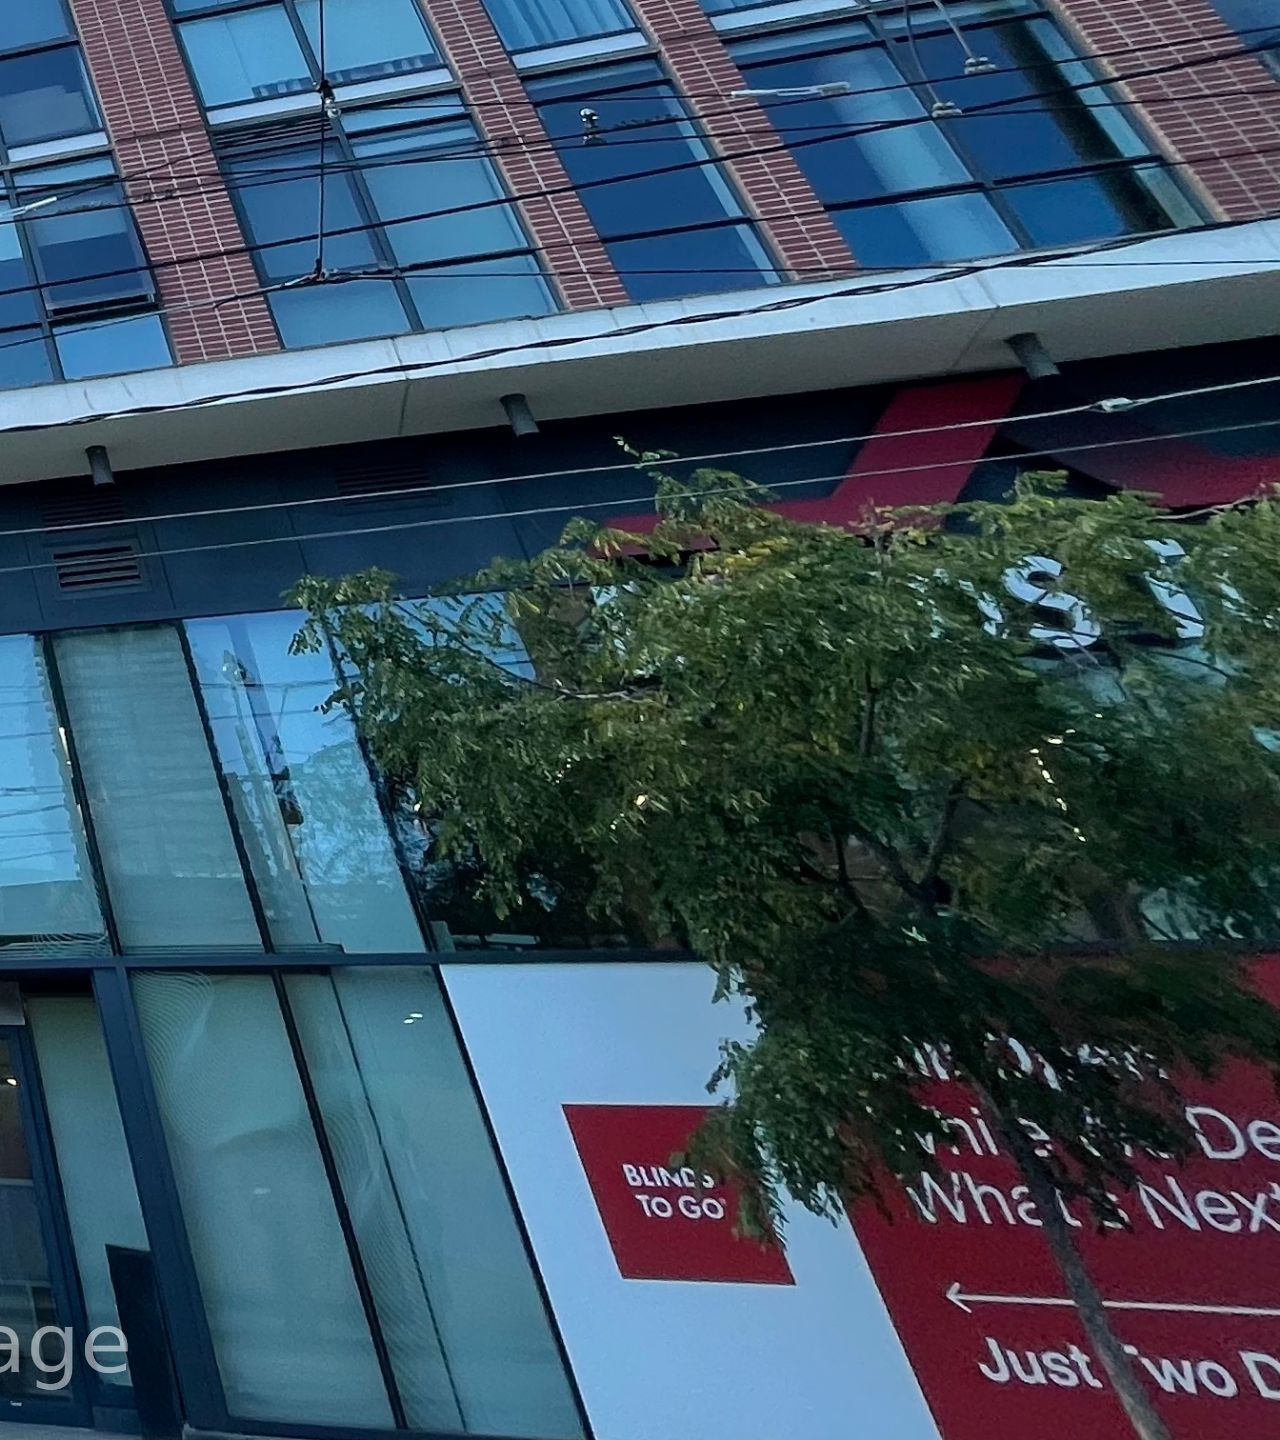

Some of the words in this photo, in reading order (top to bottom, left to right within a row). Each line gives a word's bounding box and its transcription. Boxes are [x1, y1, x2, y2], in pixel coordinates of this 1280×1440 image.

[635, 1194, 674, 1219] TO
[678, 1194, 725, 1220] GO
[905, 1170, 1132, 1230] What
[977, 1336, 1104, 1390] Just
[1123, 1342, 1239, 1398] wo
